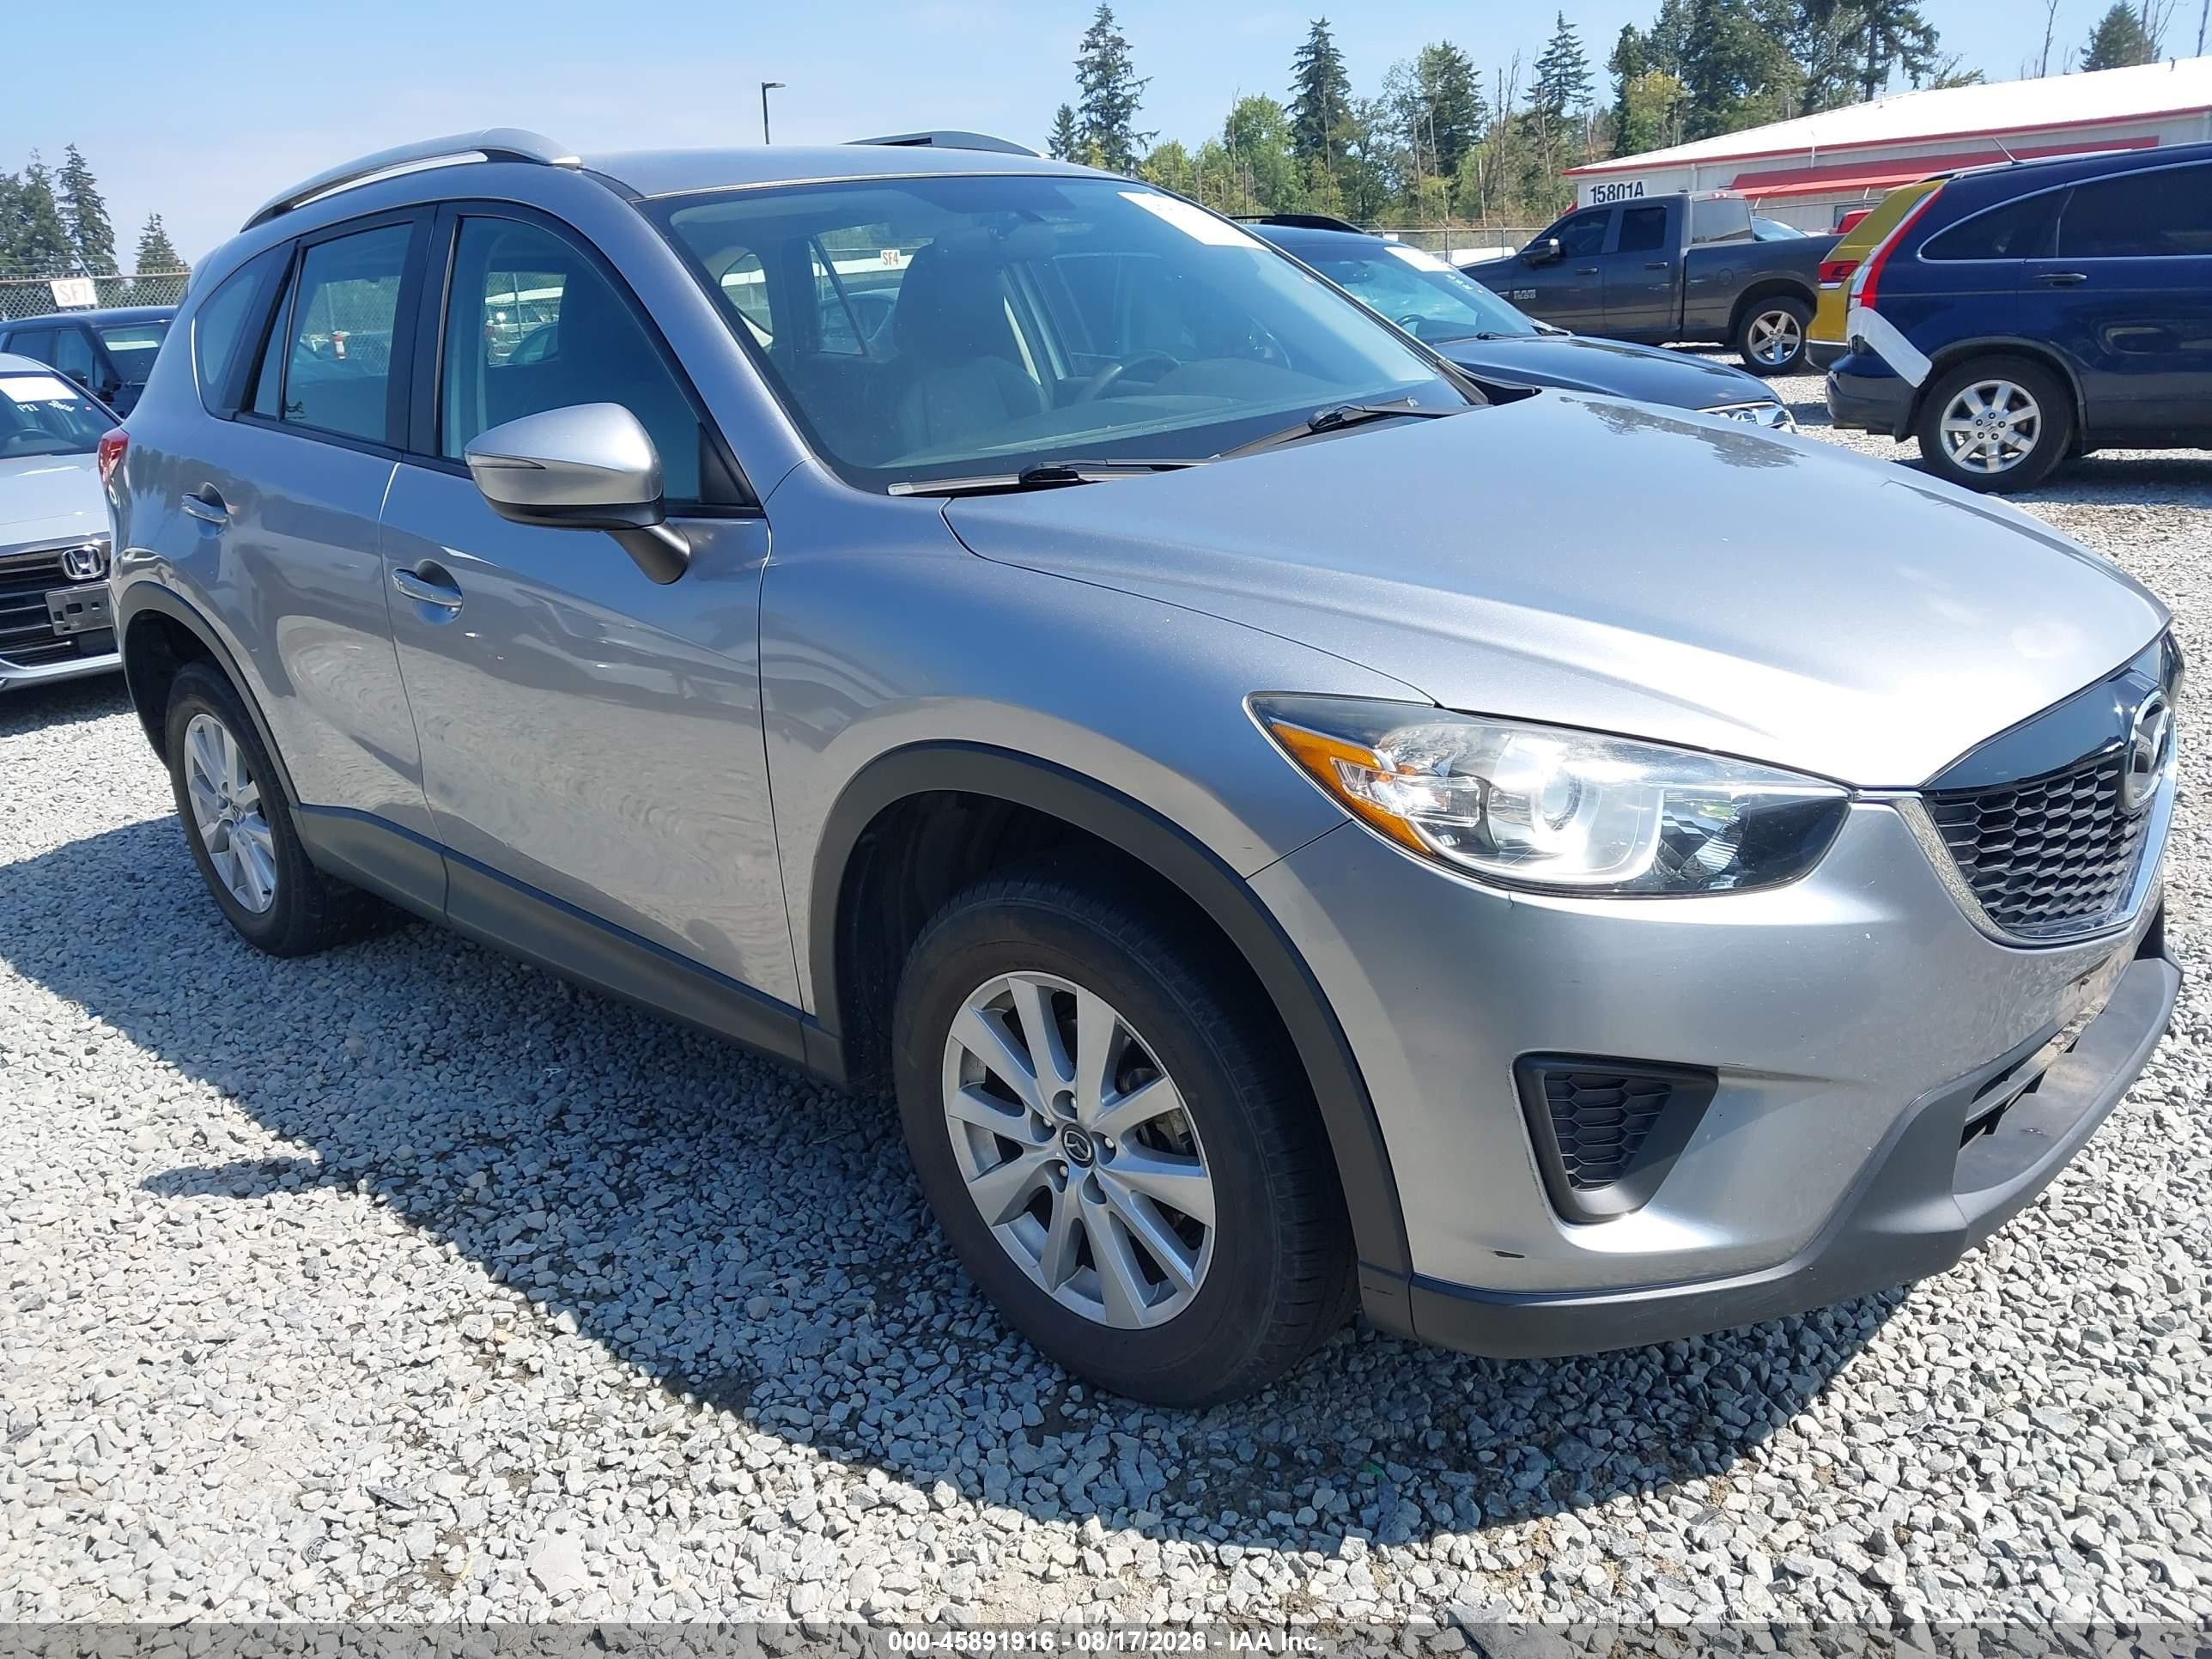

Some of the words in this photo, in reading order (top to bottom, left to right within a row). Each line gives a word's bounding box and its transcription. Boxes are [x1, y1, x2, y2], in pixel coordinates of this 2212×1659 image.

[1589, 181, 1644, 204] 15801A
[882, 251, 899, 266] SF4
[58, 283, 88, 303] SF7
